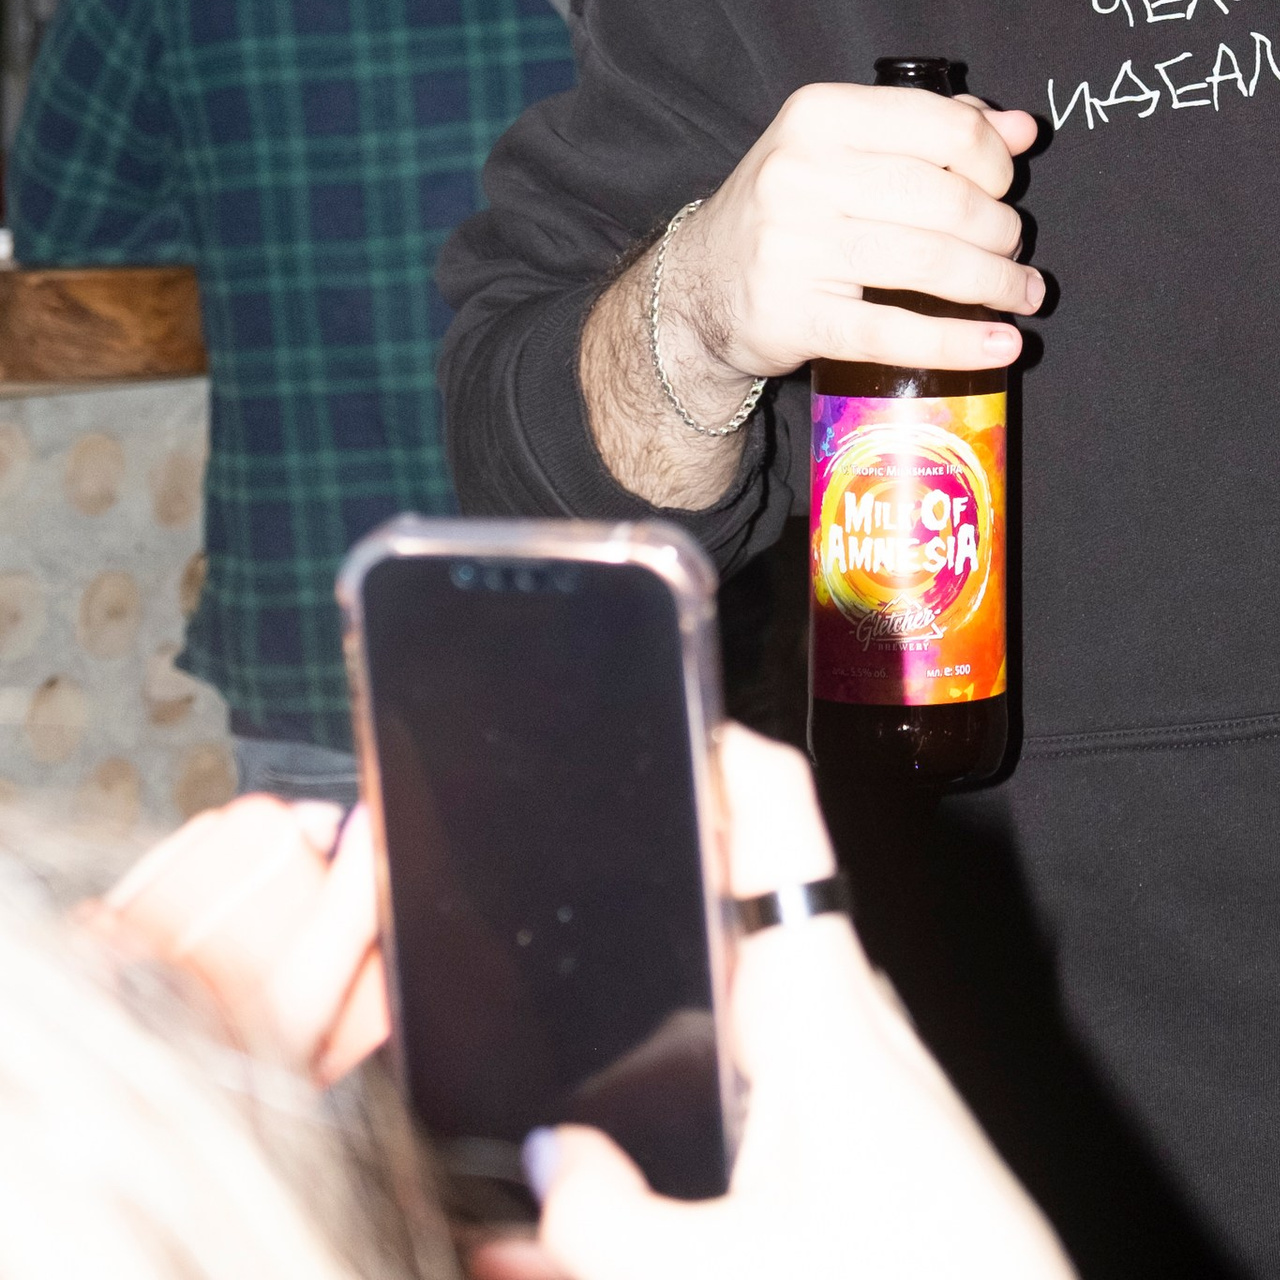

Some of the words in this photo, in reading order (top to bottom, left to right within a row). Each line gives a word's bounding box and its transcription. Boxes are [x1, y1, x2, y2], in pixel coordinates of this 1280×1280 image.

[886, 465, 944, 477] MIKSHAKE
[827, 523, 979, 576] AMNESIA
[954, 664, 971, 676] 500
